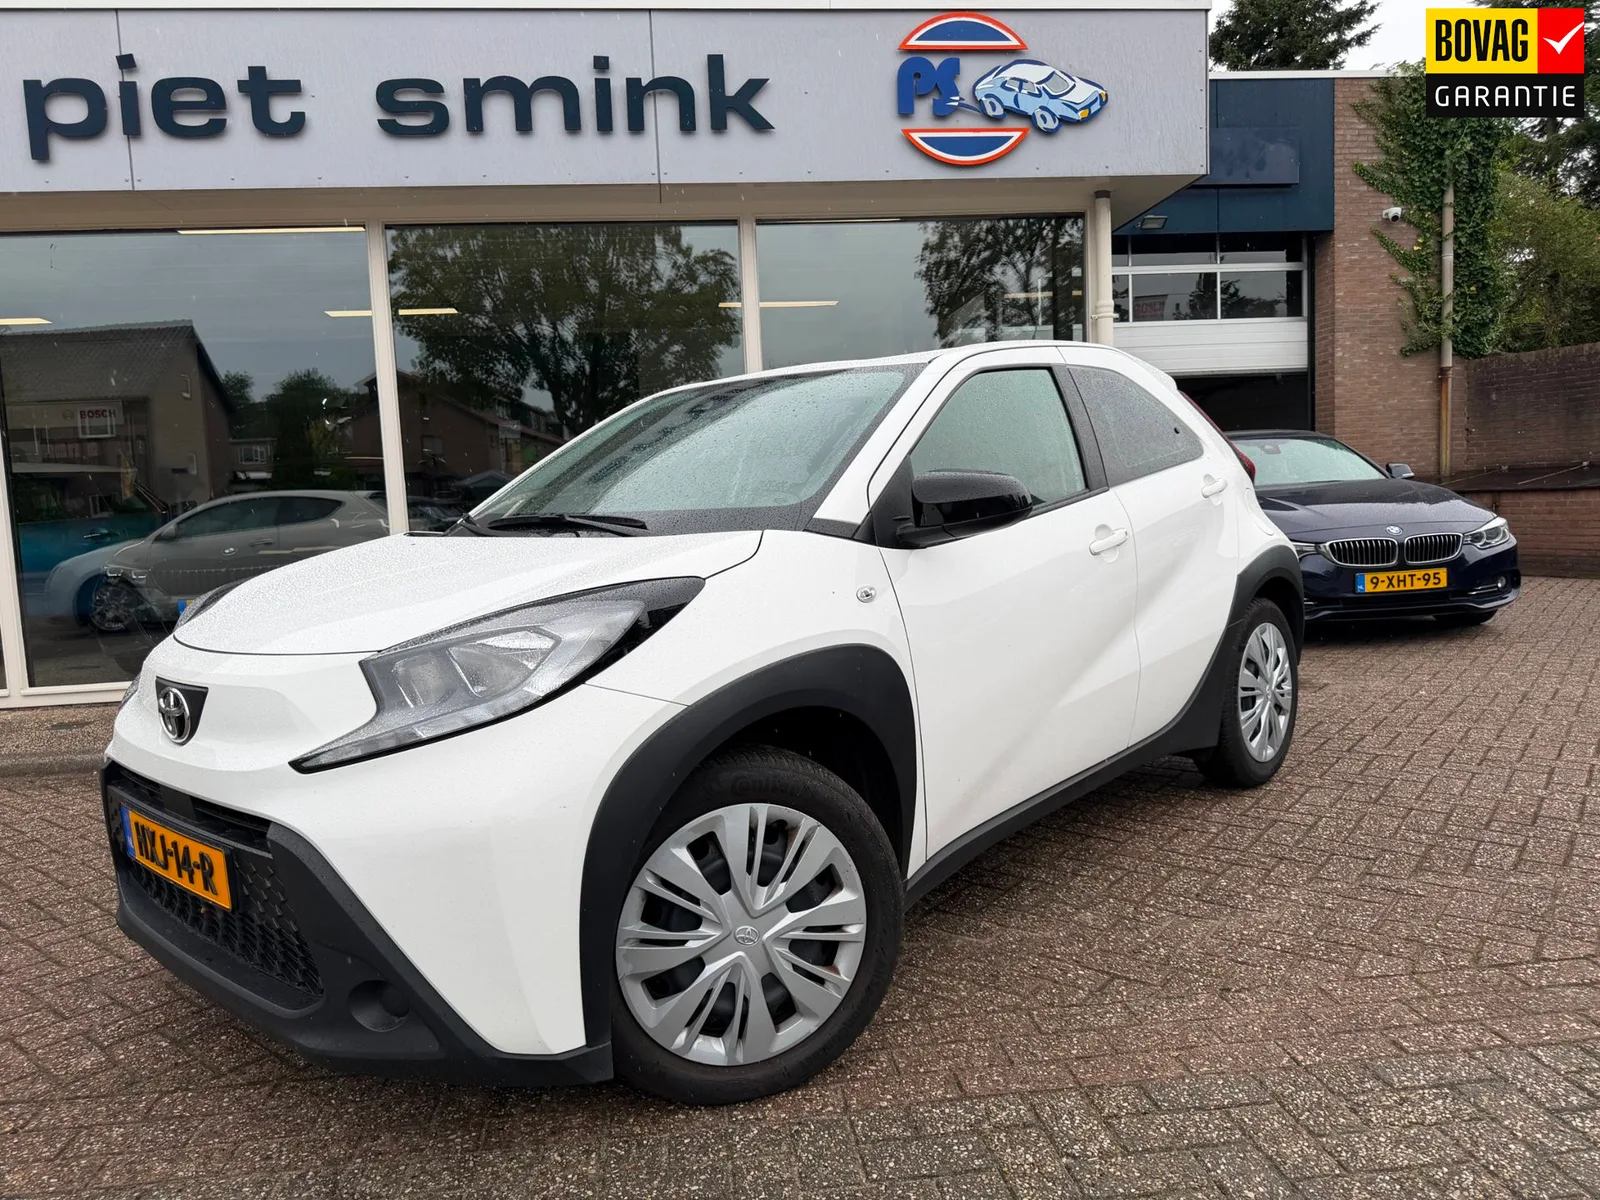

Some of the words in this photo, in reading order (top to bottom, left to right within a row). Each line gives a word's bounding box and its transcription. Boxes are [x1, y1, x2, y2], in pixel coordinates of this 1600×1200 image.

[23, 53, 306, 161] piet
[376, 54, 776, 136] smink
[79, 408, 117, 419] BOSCH
[1370, 572, 1441, 589] 9-XHT-95
[134, 821, 218, 896] HXJ-14-R
